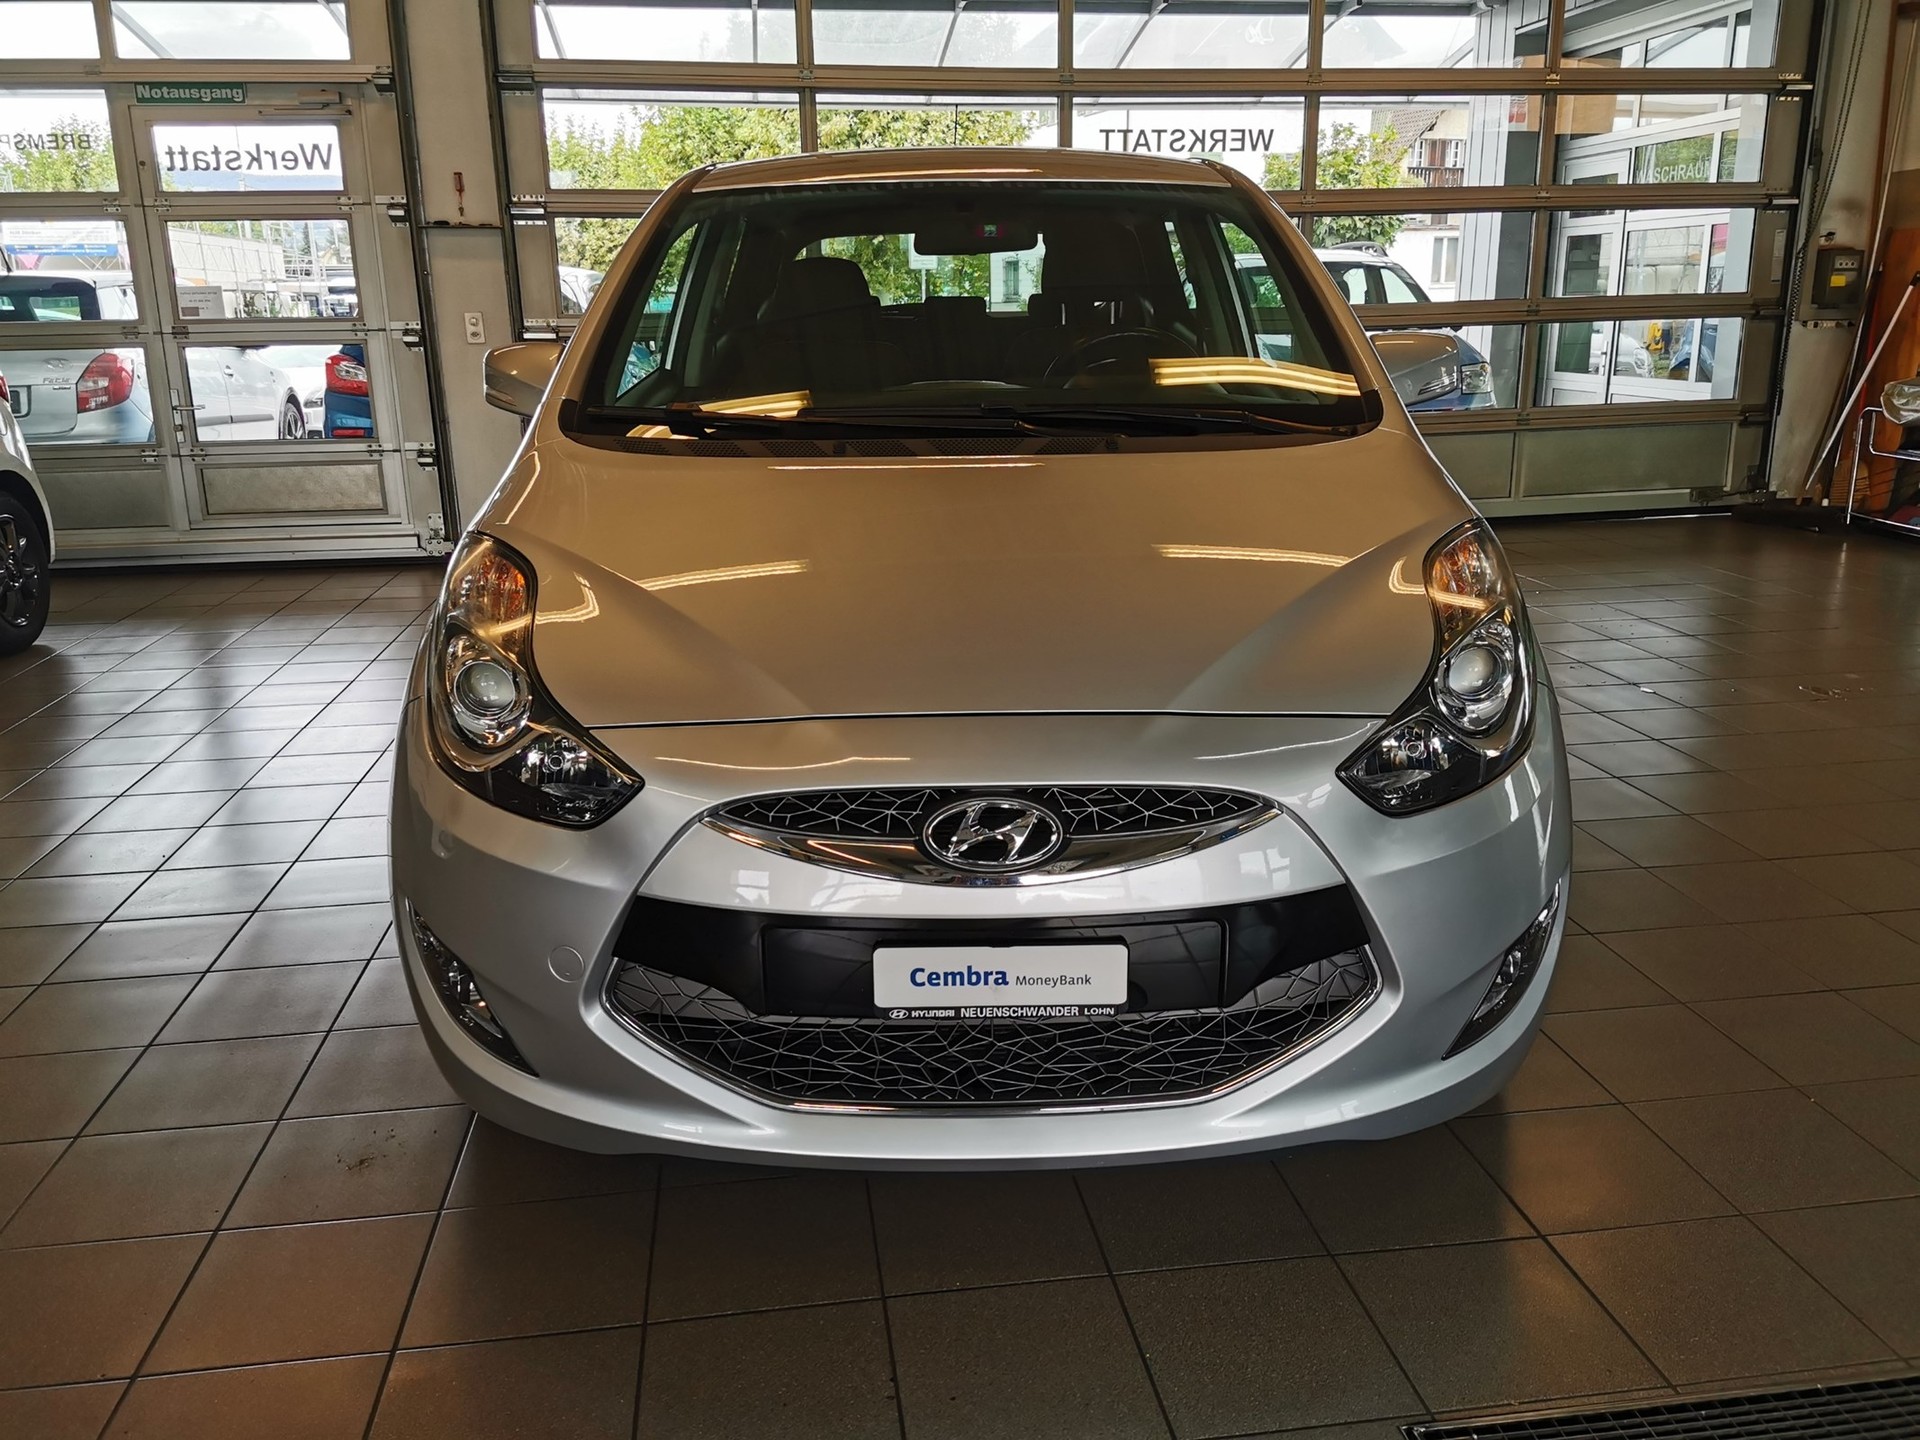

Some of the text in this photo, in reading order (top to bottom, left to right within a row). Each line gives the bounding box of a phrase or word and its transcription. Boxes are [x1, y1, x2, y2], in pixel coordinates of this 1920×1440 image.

[136, 84, 244, 102] Notausgang
[909, 965, 1092, 988] Cembra MoneyBank
[911, 1006, 1115, 1018] HYUNDAI NEUENSCHWANDER LOHN
